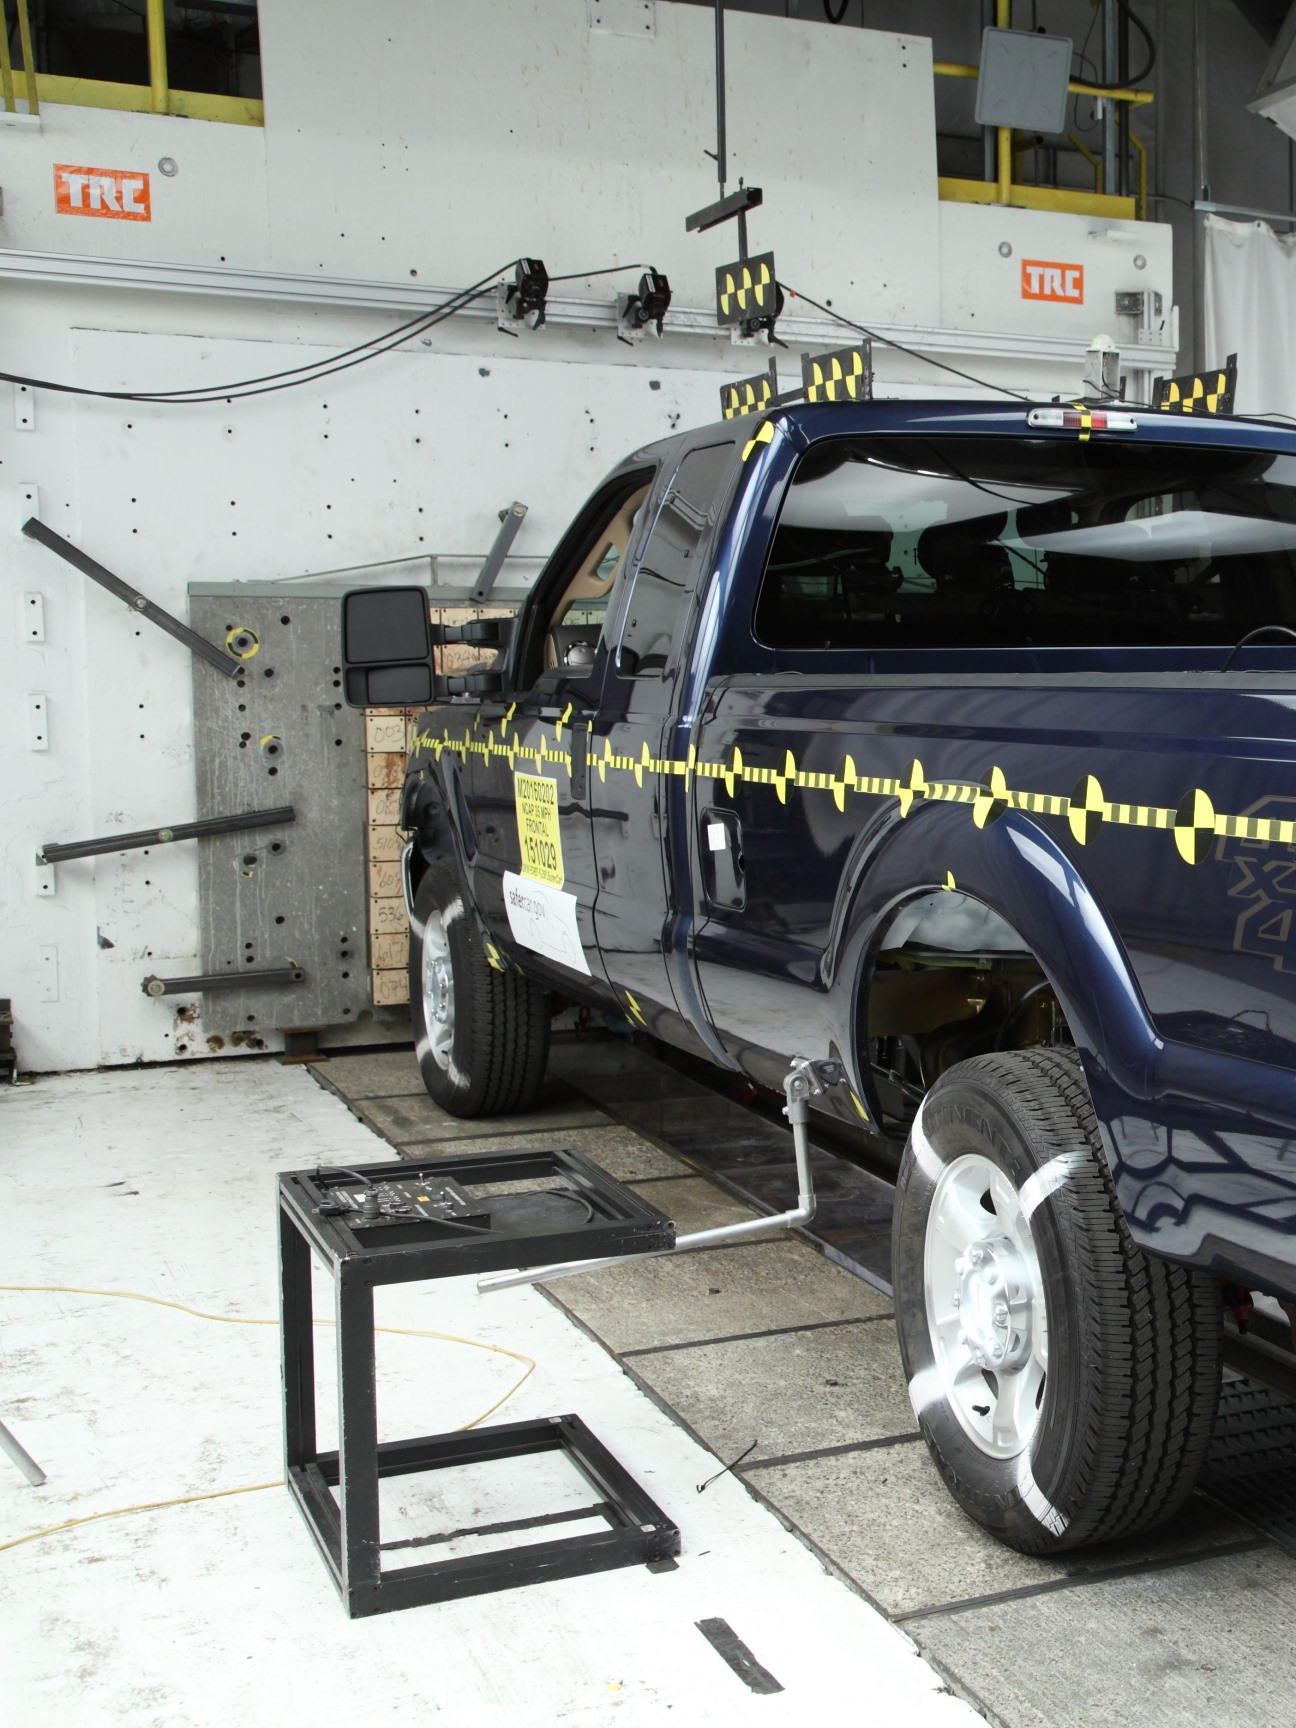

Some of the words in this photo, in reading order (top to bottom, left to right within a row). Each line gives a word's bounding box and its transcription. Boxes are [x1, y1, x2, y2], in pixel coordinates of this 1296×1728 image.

[62, 173, 145, 213] TRC
[1026, 266, 1080, 297] TRC
[517, 777, 555, 805] M20160202
[525, 817, 550, 837] FRONTAL
[524, 835, 557, 871] 151029
